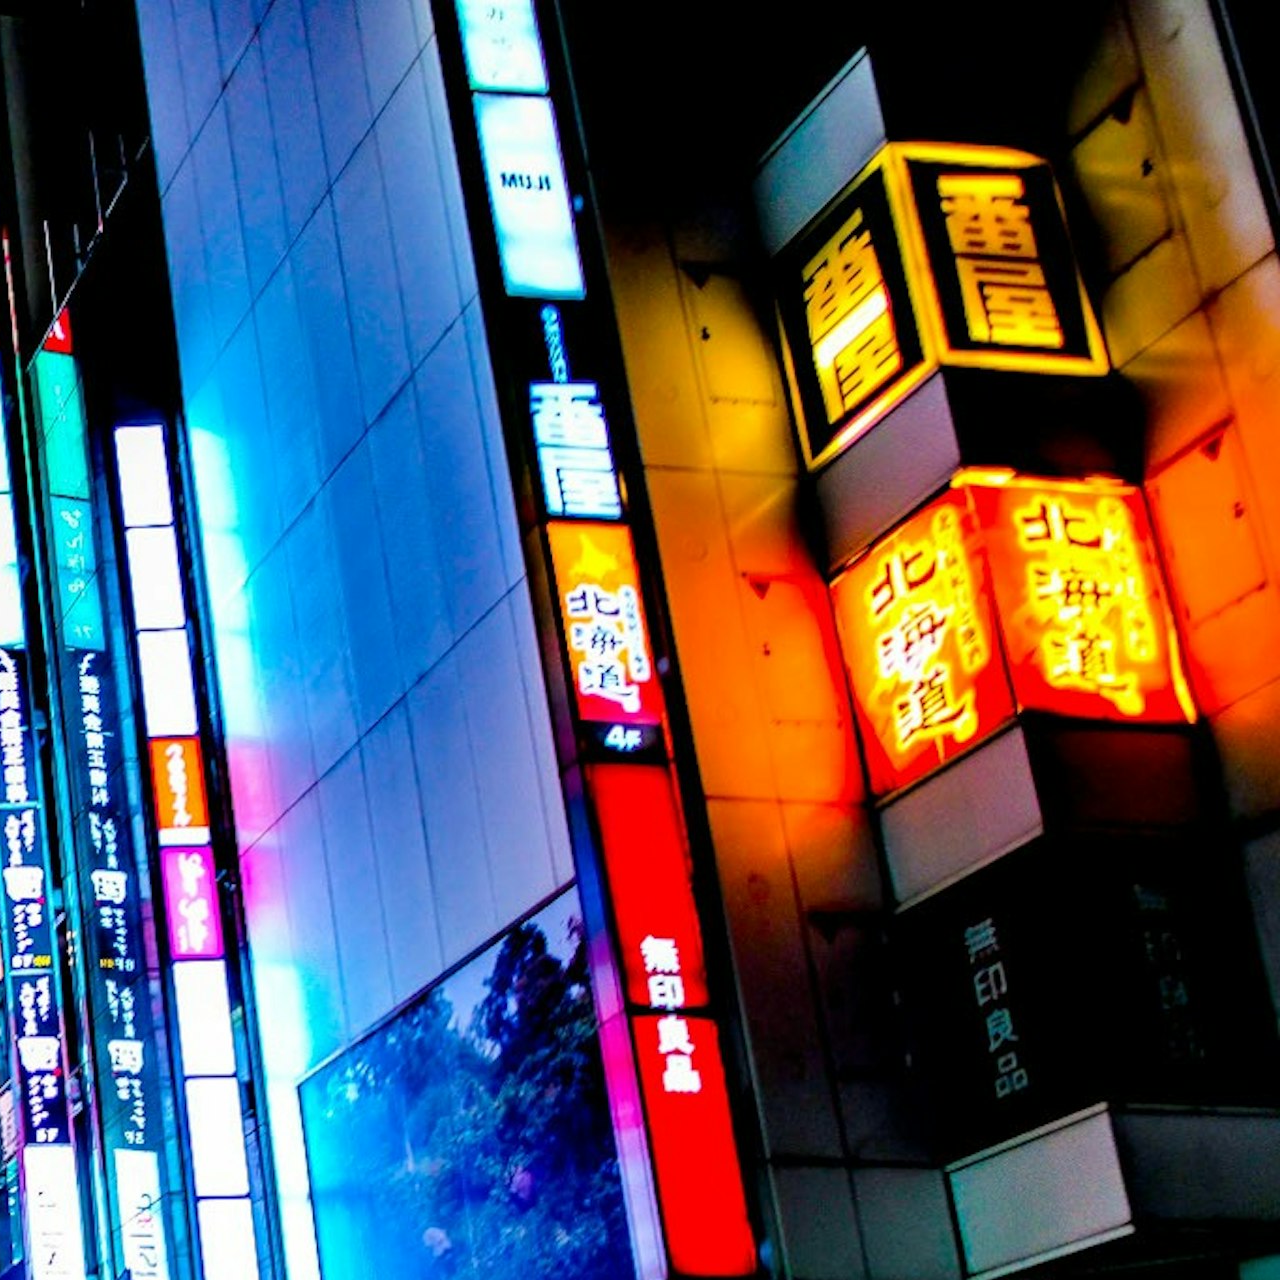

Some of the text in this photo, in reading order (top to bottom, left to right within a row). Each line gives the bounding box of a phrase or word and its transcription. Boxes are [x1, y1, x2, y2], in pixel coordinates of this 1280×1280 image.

[500, 172, 551, 192] MUJI
[937, 174, 1065, 350] 番屋
[801, 206, 903, 424] 番屋
[568, 588, 636, 703] 北海道
[870, 549, 967, 746] 北海道
[1021, 500, 1132, 696] 北海道
[639, 934, 702, 1096] 無印良品
[964, 917, 1029, 1099] 無印良品
